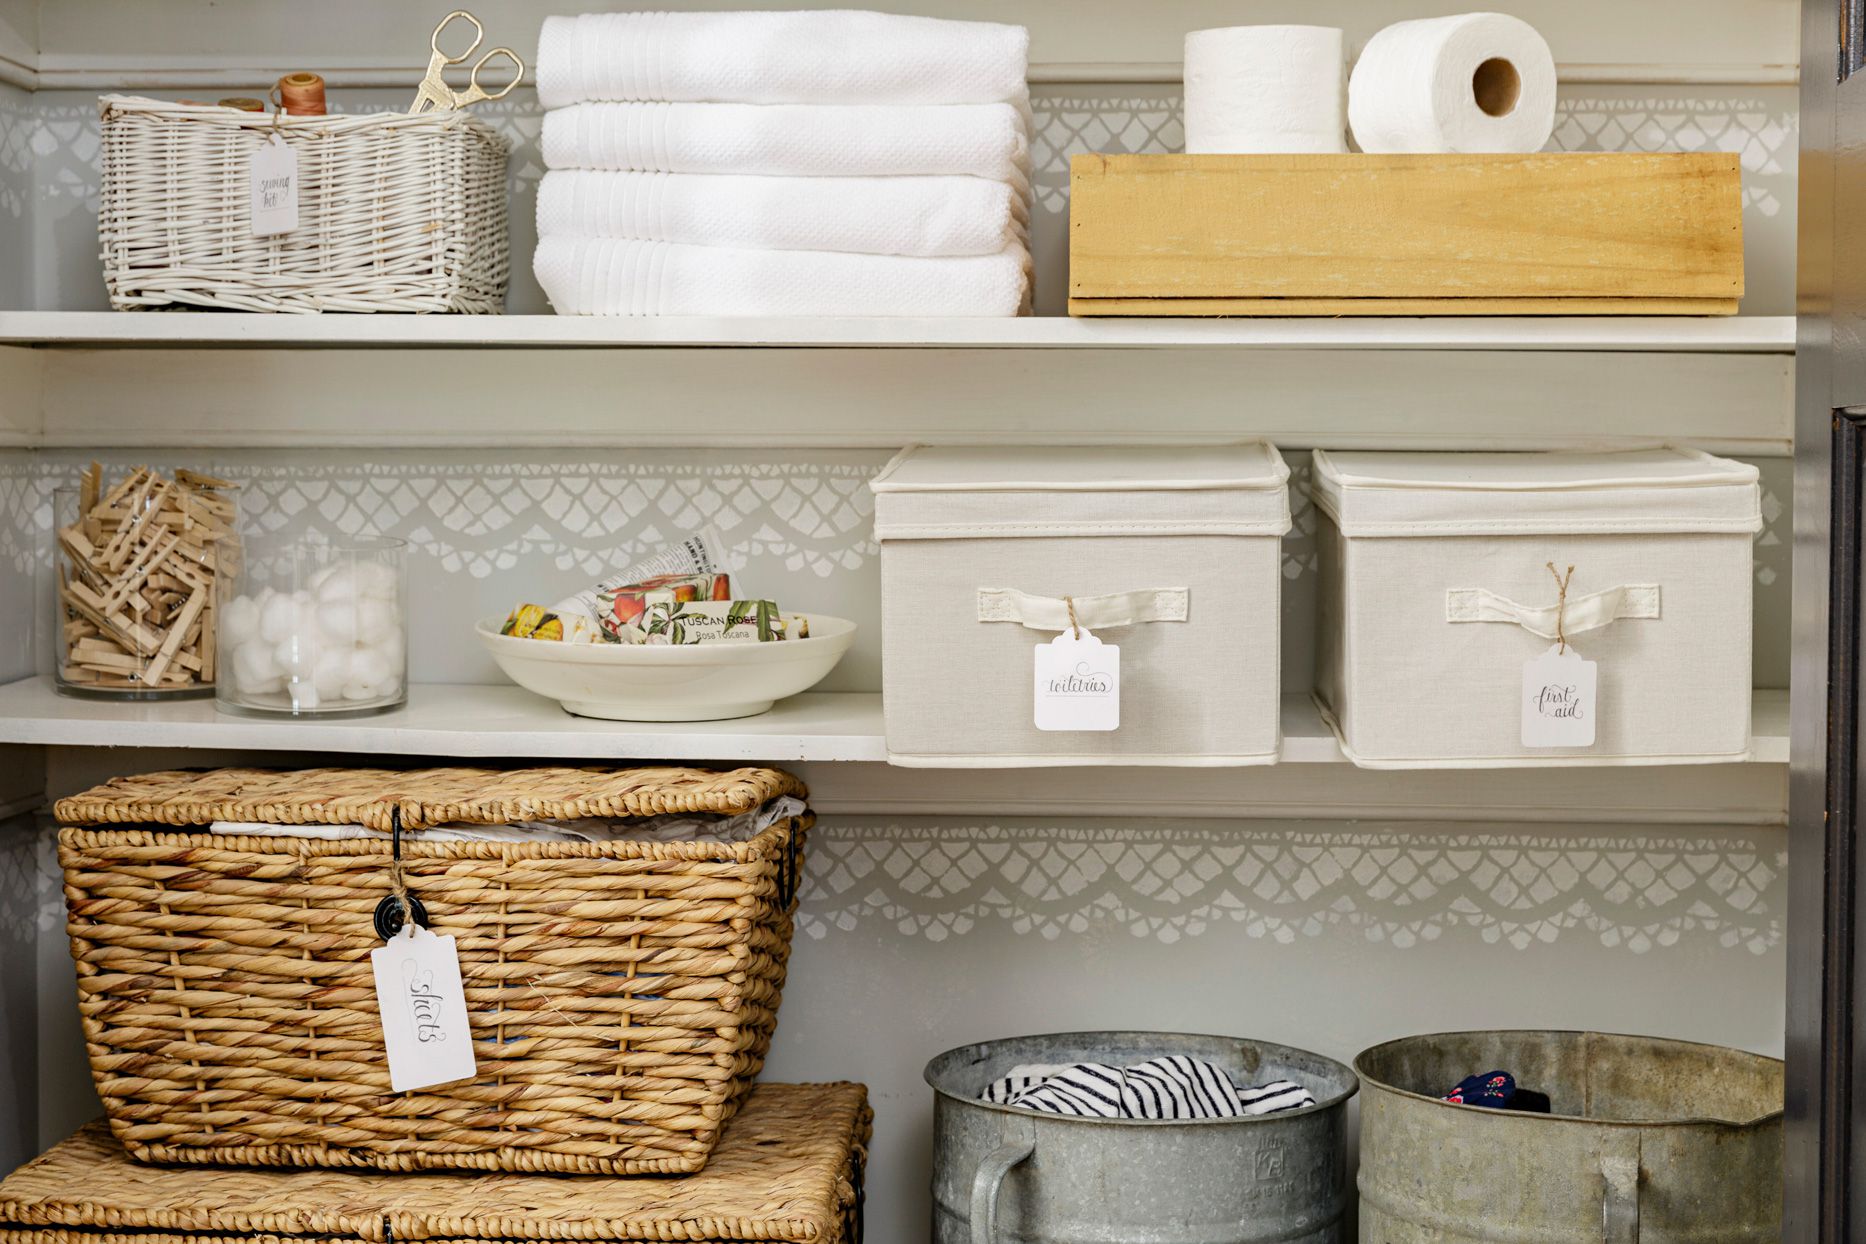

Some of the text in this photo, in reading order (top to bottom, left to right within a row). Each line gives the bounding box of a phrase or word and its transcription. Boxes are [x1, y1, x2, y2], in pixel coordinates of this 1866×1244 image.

[682, 614, 758, 626] TUSCAN ROSE
[696, 630, 750, 640] Rosa Toscana
[1533, 684, 1576, 713] first
[1549, 698, 1583, 719] aid
[406, 969, 446, 1042] sheets
